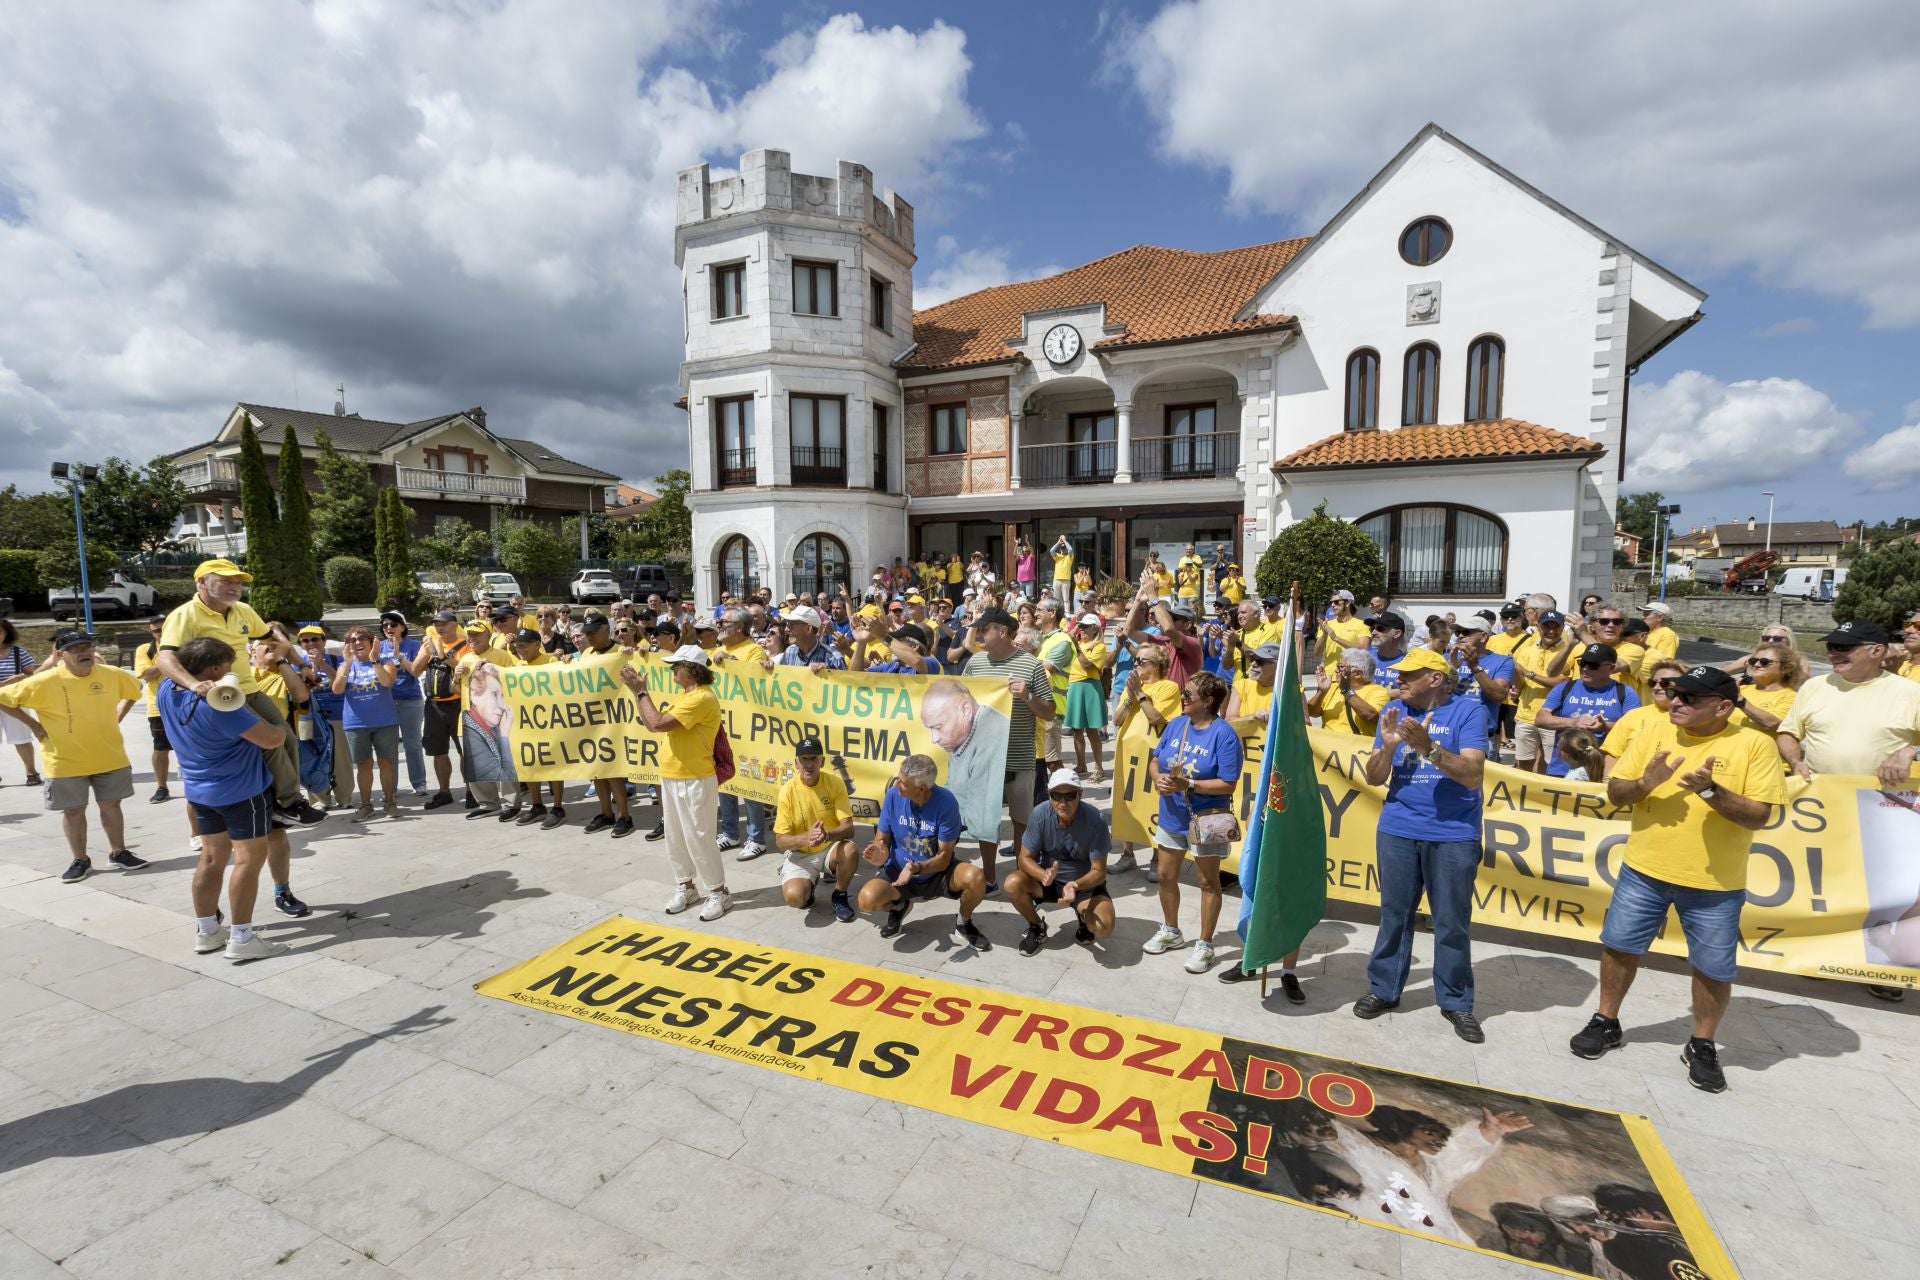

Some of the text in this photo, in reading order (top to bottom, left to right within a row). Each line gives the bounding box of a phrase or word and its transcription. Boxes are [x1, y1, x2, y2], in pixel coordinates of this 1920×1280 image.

[1385, 669, 1400, 679] Mov
[505, 671, 553, 698] POR
[558, 667, 618, 696] UNA
[750, 673, 803, 712] MÁS
[812, 683, 914, 721] JUSTA
[1568, 695, 1613, 707] On The Move
[1428, 723, 1450, 735] Move
[520, 741, 556, 767] DE
[559, 737, 616, 765] LOS
[1819, 964, 1918, 983] ASOCIACIÓN DE
[508, 991, 806, 1072] Asociación de Maltratados por la Administración
[575, 931, 1376, 1118] ¡HABÉIS DESTROZADO
[525, 965, 1274, 1175] NUESTRAS VIDAS!
